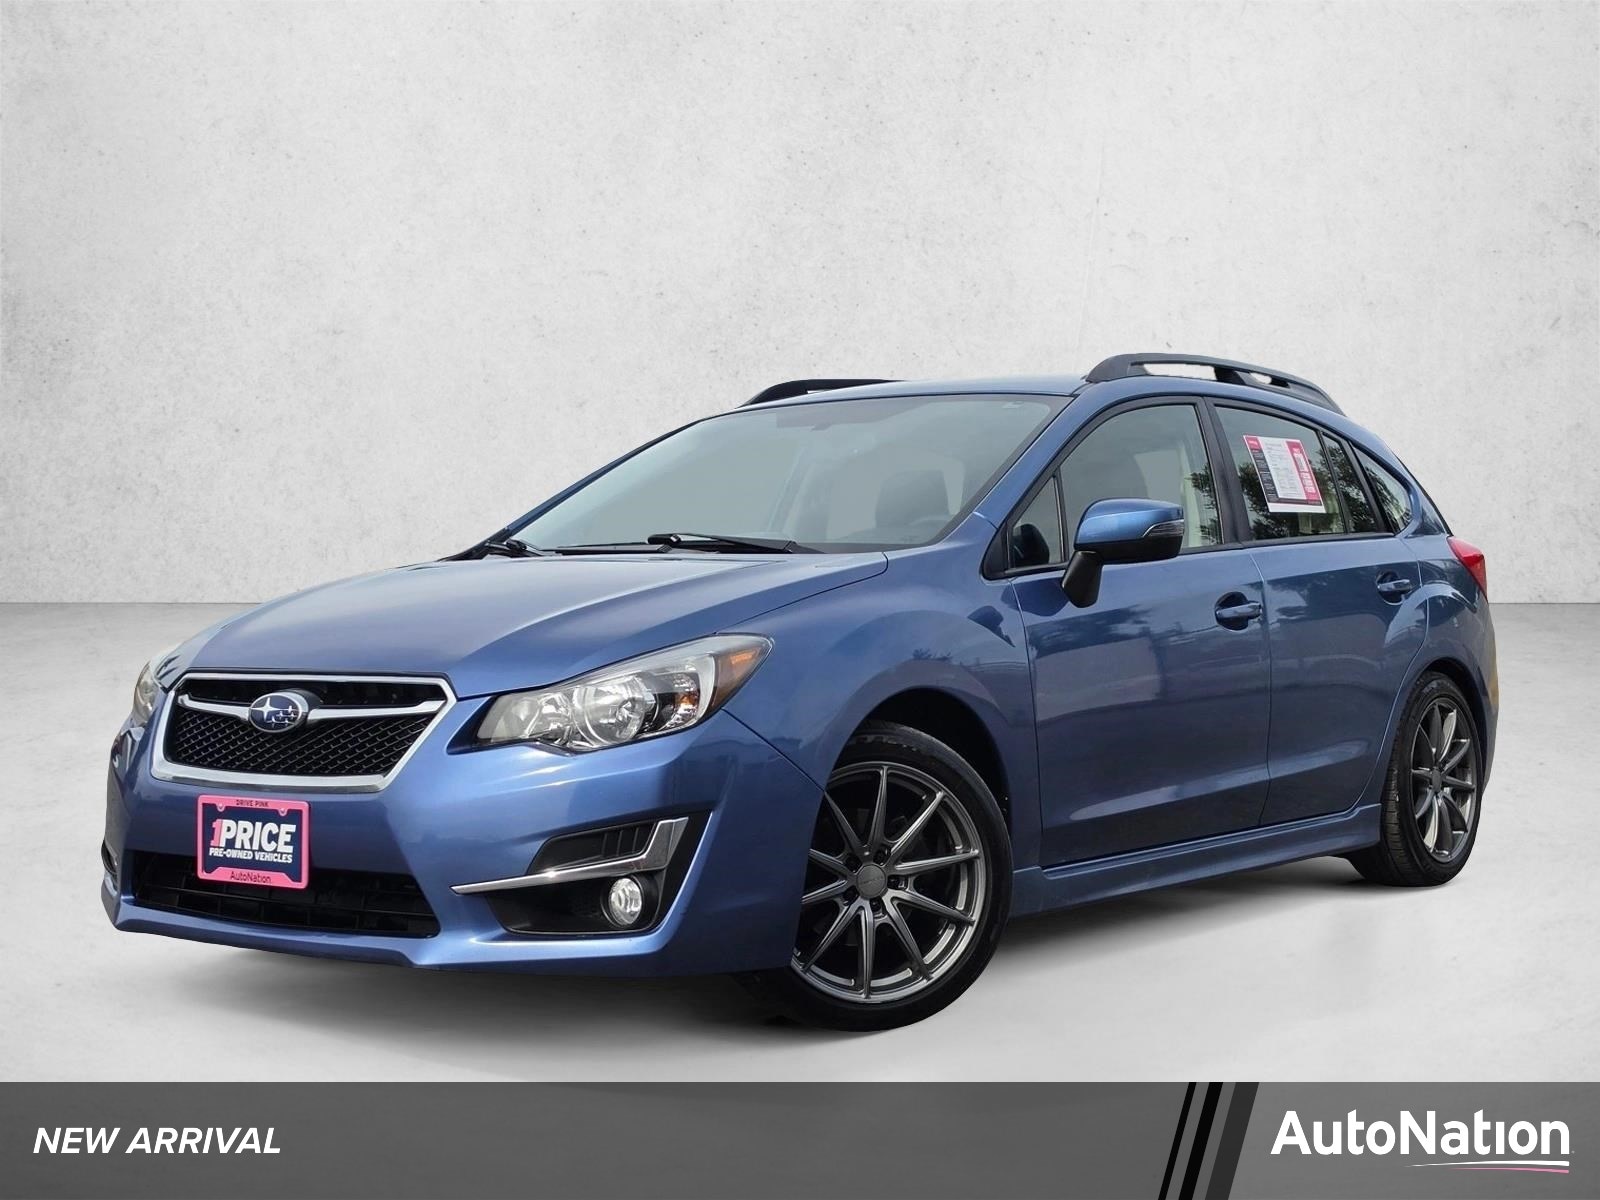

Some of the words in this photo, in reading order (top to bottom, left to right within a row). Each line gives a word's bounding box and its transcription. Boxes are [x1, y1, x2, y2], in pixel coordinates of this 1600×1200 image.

[236, 799, 254, 807] DRIVE
[209, 847, 253, 860] PRE-OWNED
[255, 852, 293, 863] VEHICLES
[230, 871, 272, 883] AutoNation
